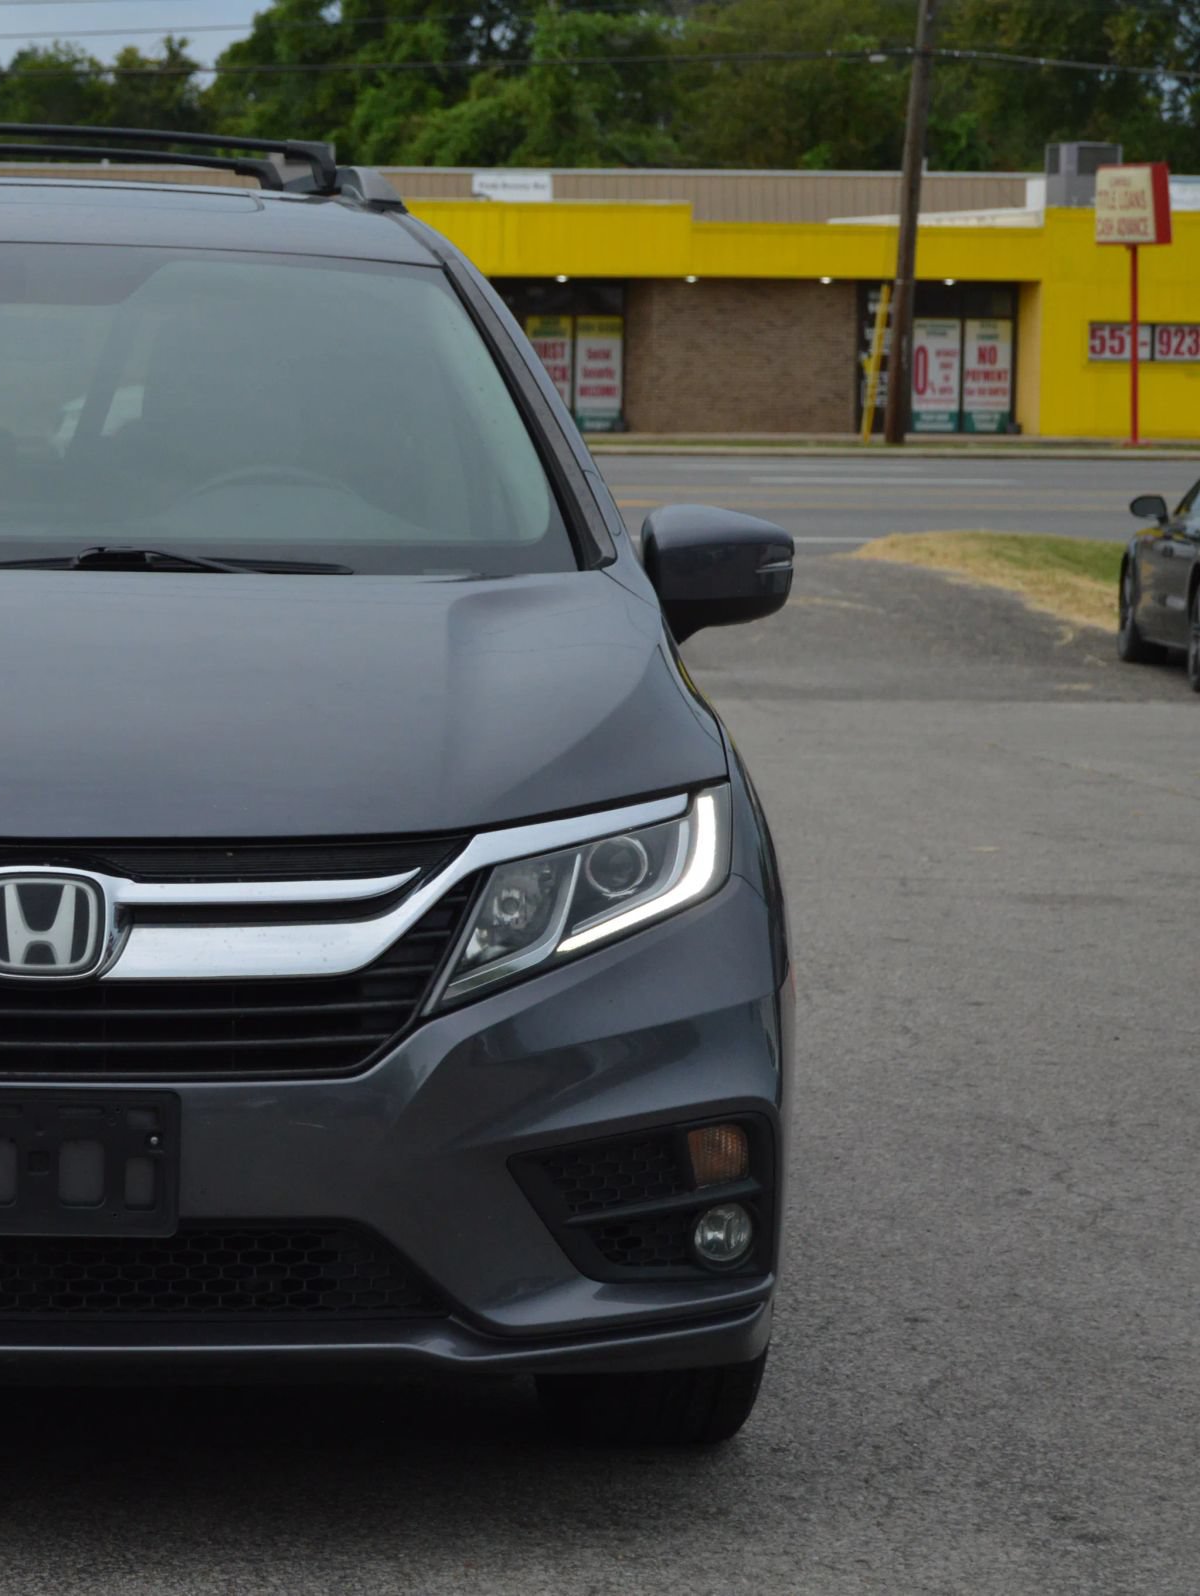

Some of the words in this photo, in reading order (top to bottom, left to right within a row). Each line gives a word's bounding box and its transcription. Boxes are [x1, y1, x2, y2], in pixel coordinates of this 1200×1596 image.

[1119, 189, 1146, 210] LOANS
[1116, 216, 1149, 237] ADVANCE
[977, 345, 998, 366] NO
[965, 368, 1010, 382] PAYMENT
